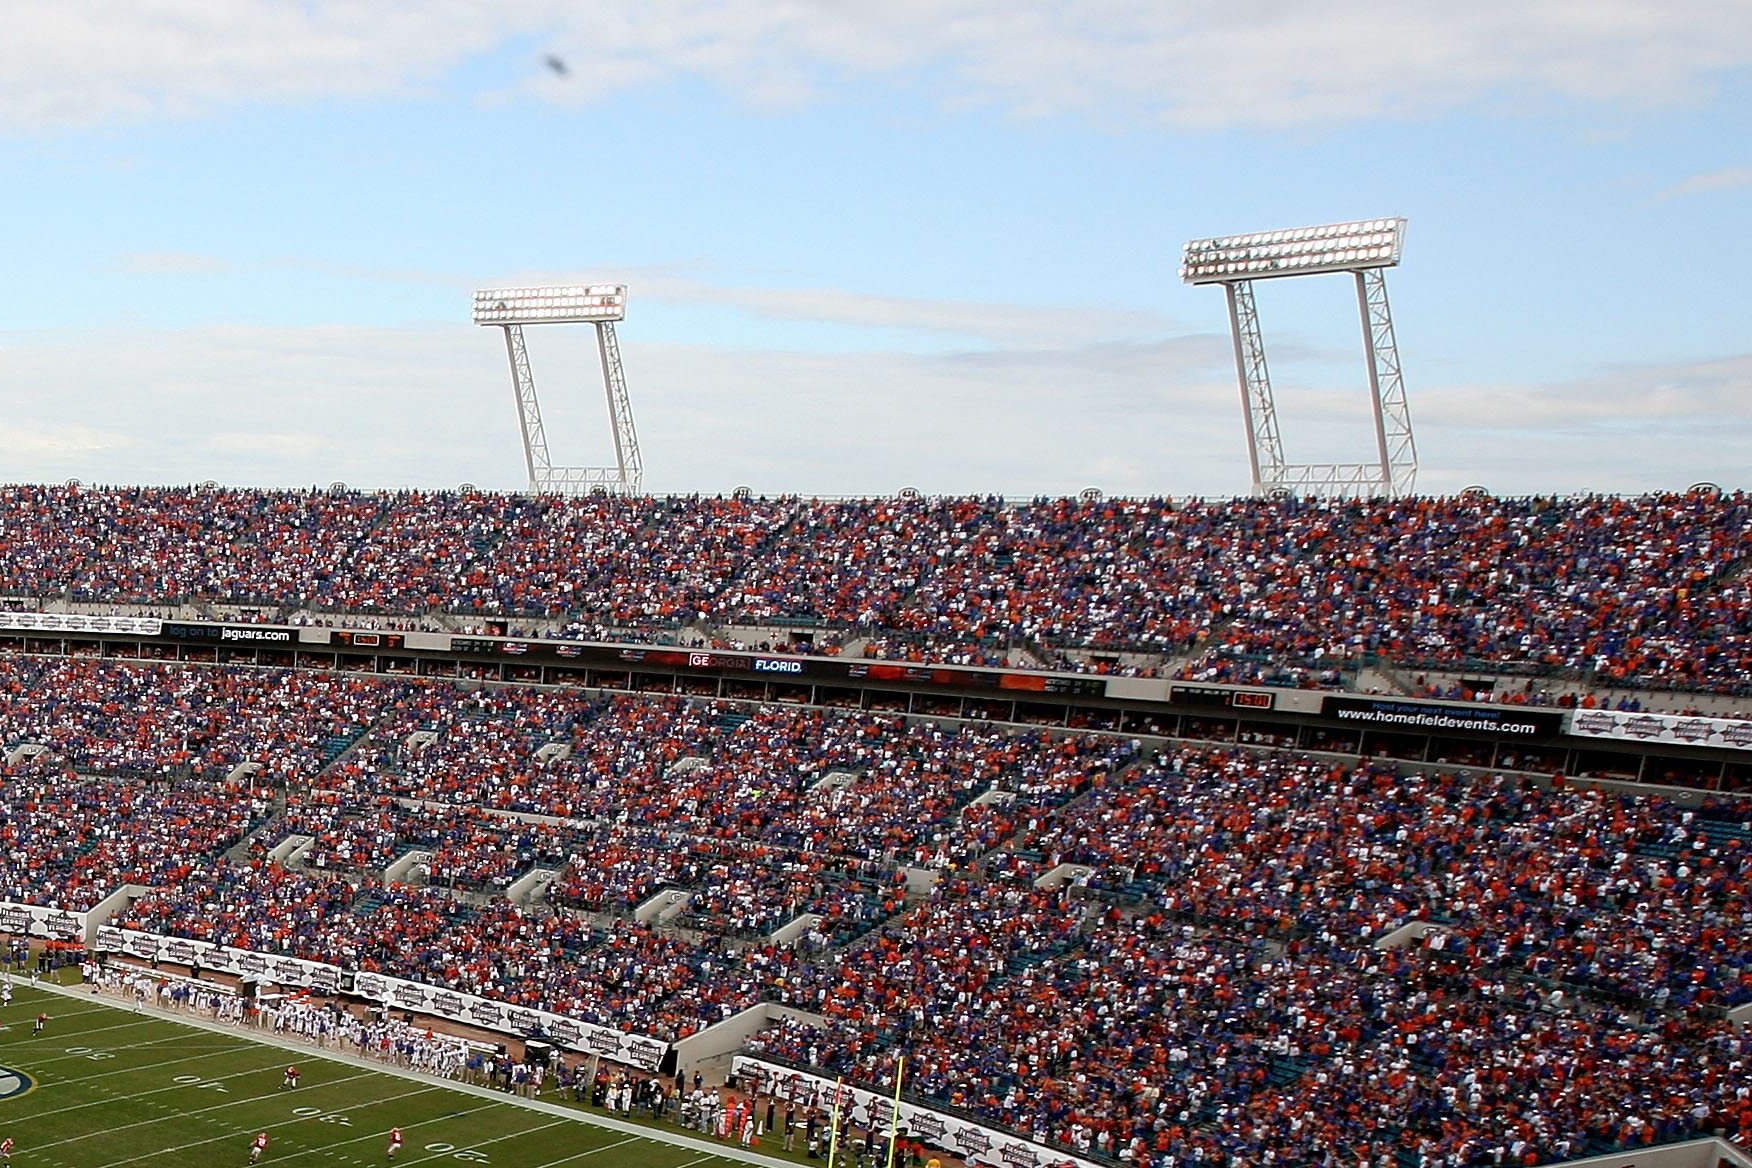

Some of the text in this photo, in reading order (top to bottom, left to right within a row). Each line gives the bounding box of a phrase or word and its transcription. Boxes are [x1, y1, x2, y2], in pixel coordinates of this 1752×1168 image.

[207, 628, 219, 637] to
[221, 627, 290, 641] jaguars.com
[692, 655, 747, 668] GEORGIA
[755, 659, 802, 673] FLORID
[1372, 702, 1394, 711] Host
[1396, 704, 1419, 714] your
[1421, 706, 1443, 715] next
[1444, 709, 1472, 718] event
[1337, 708, 1536, 734] www.homefieldevents.com
[2, 909, 31, 919] FLORIDA
[50, 915, 77, 925] GEORGIA
[48, 924, 77, 933] FLORIDA
[552, 1021, 579, 1033] FLORIDA
[551, 1031, 578, 1044] GEORGIA
[592, 1032, 620, 1043] GEORGIA
[591, 1041, 618, 1053] FLORIDA
[632, 1042, 660, 1054] FLORIDA
[631, 1052, 659, 1063] GEORGIA
[914, 1115, 943, 1128] GEORGIA
[912, 1124, 942, 1138] FLORIDA
[960, 1128, 989, 1143] FLORIDA
[958, 1138, 987, 1152] GEORGIA
[1005, 1144, 1037, 1160] GEORGIA
[1003, 1154, 1035, 1168] FLORIDA
